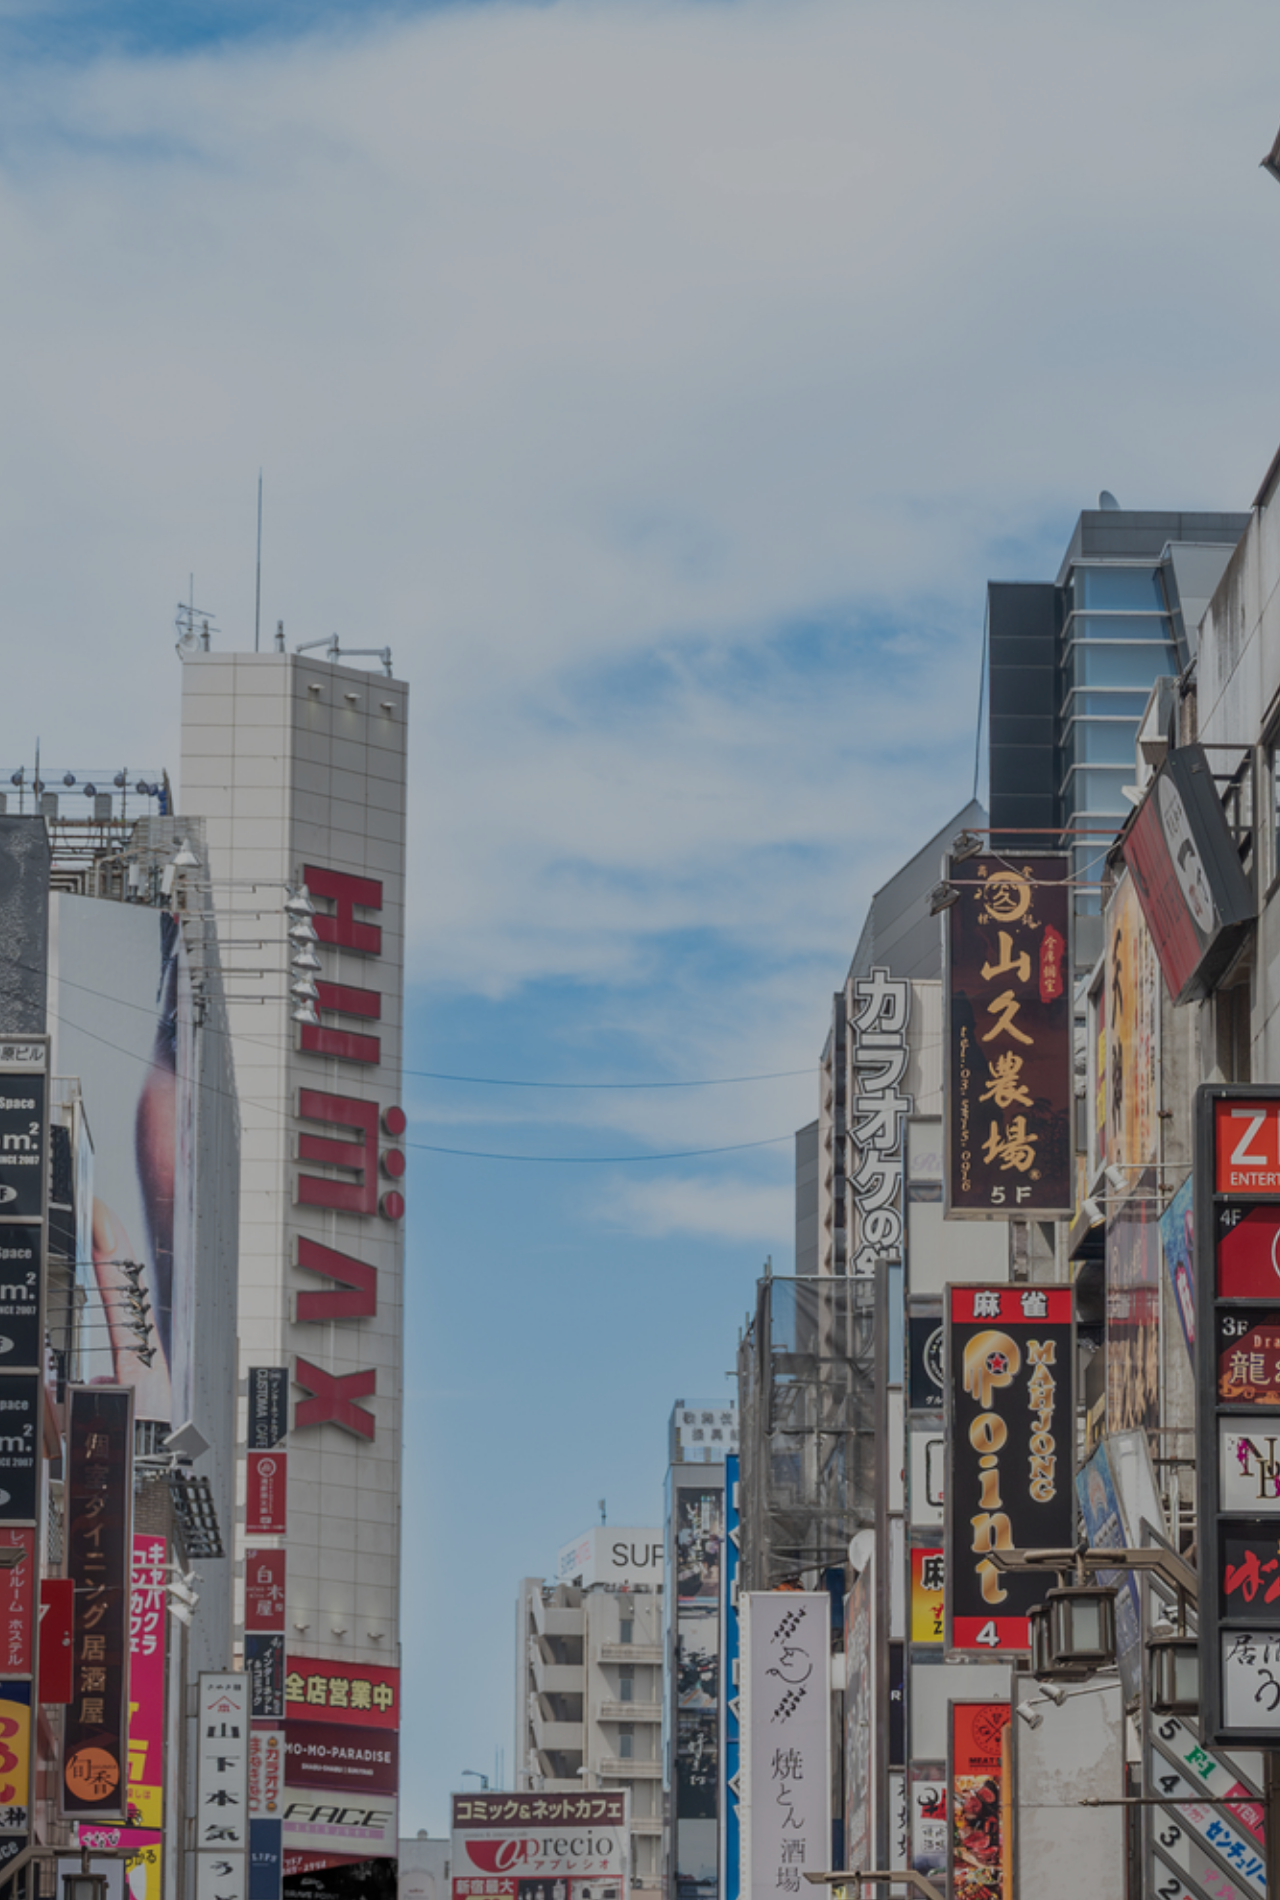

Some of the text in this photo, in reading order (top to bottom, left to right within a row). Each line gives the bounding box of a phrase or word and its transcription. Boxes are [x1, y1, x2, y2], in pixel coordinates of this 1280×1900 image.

[978, 930, 1040, 1174] 山久農場
[1219, 1208, 1242, 1227] 4F
[14, 1304, 37, 1316] 2007
[972, 1290, 1049, 1319] 麻雀
[1221, 1316, 1249, 1337] 3F
[1025, 1338, 1057, 1503] MAHJONG
[10, 1457, 34, 1468] 2007
[141, 1543, 166, 1656] キャバクラ
[255, 1564, 285, 1617] 白木屋
[285, 1671, 395, 1713] 全店営業中
[1158, 1718, 1183, 1741] 5
[283, 1802, 394, 1829] FACE
[456, 1798, 622, 1821] コミック&ネットカフェ
[770, 1747, 807, 1894] 焼とん酒場
[1159, 1825, 1182, 1848] 3
[533, 1858, 611, 1872] アプレシオ
